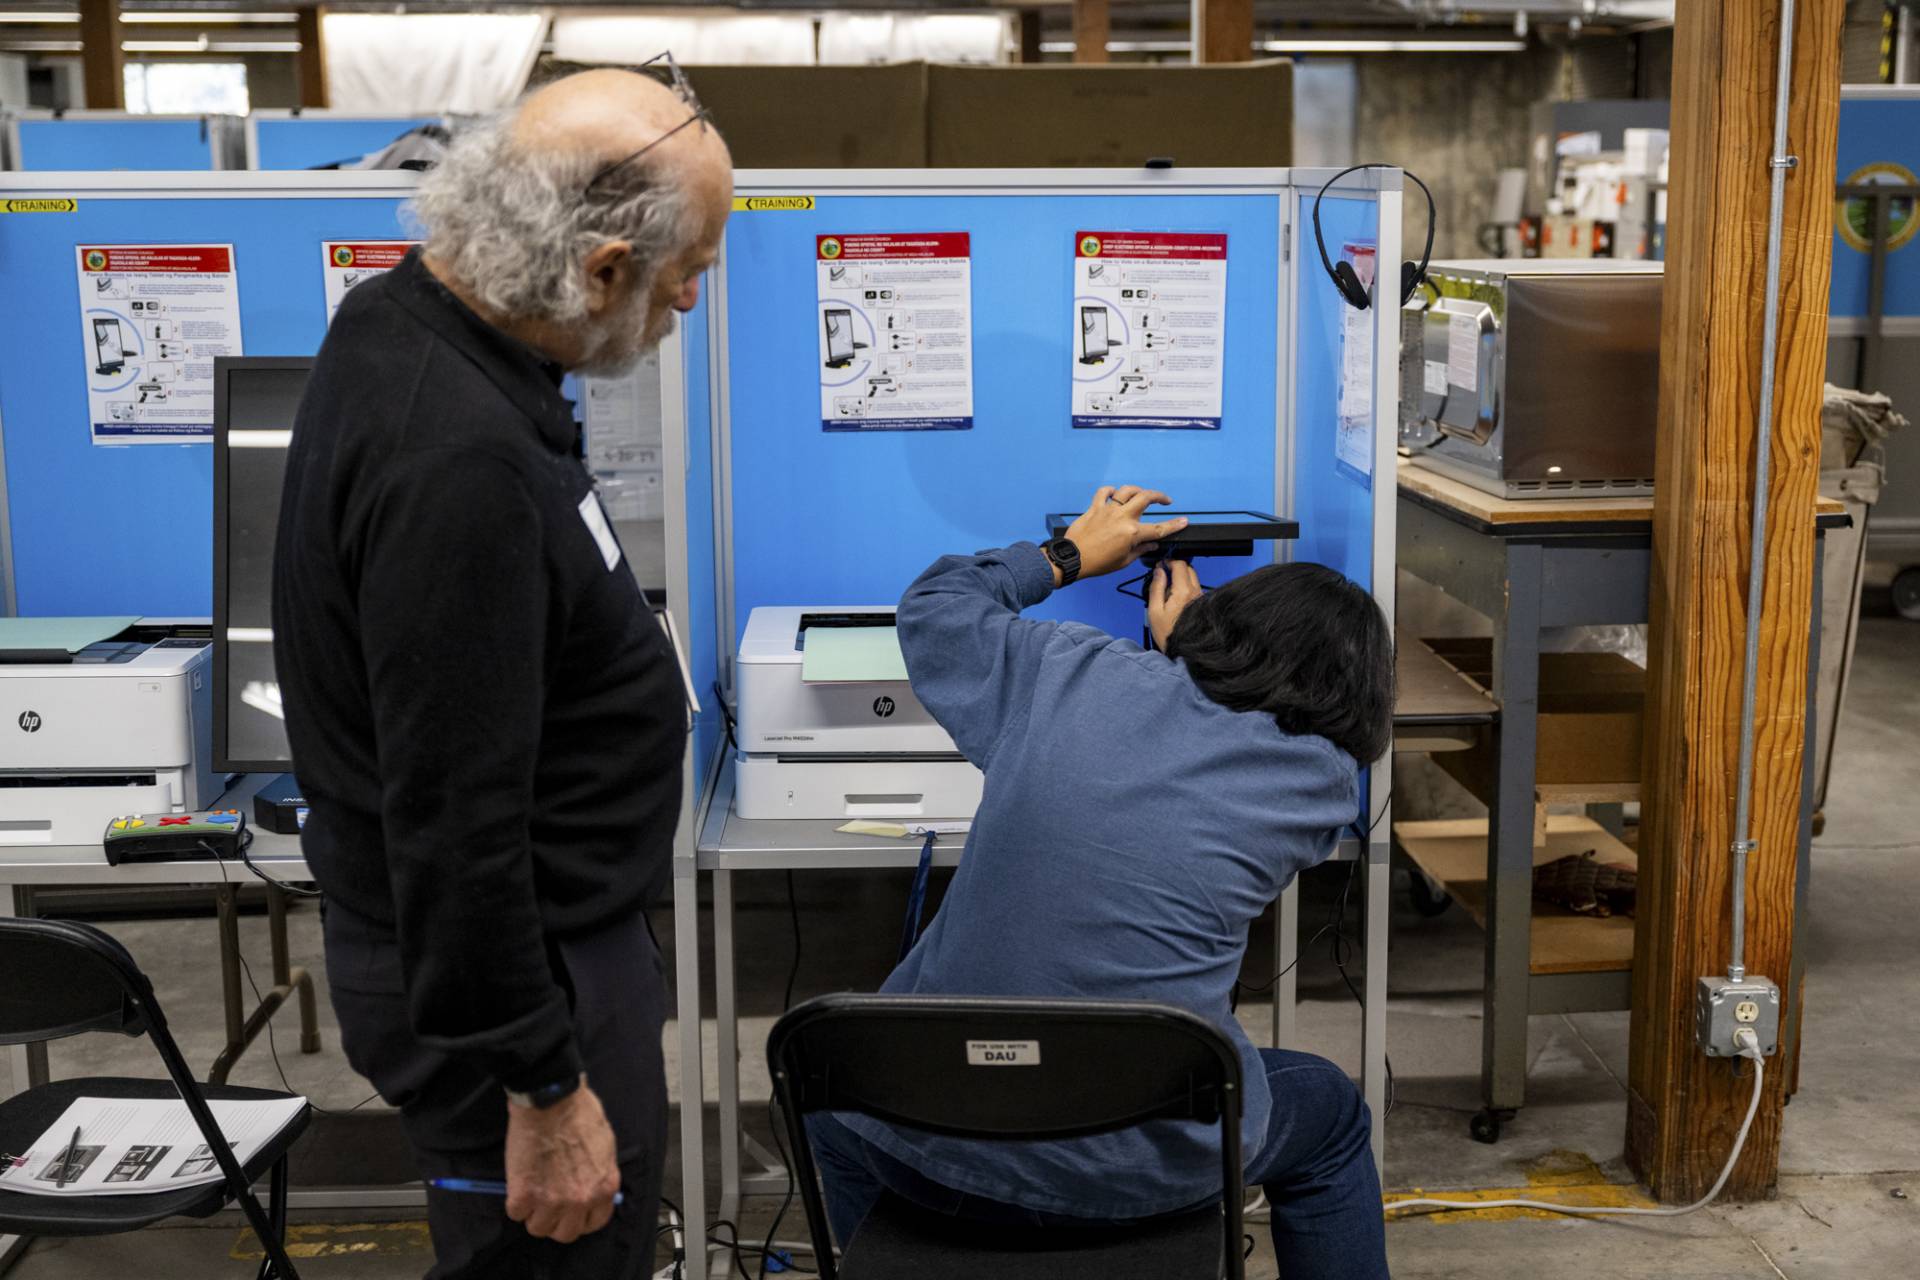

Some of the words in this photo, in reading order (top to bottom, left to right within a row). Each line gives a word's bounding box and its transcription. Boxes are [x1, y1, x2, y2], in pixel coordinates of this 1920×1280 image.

[14, 201, 66, 210] TRAINING
[753, 199, 804, 208] TRAINING
[874, 696, 894, 718] hp
[19, 711, 41, 733] hp
[984, 1051, 1016, 1062] DAU
